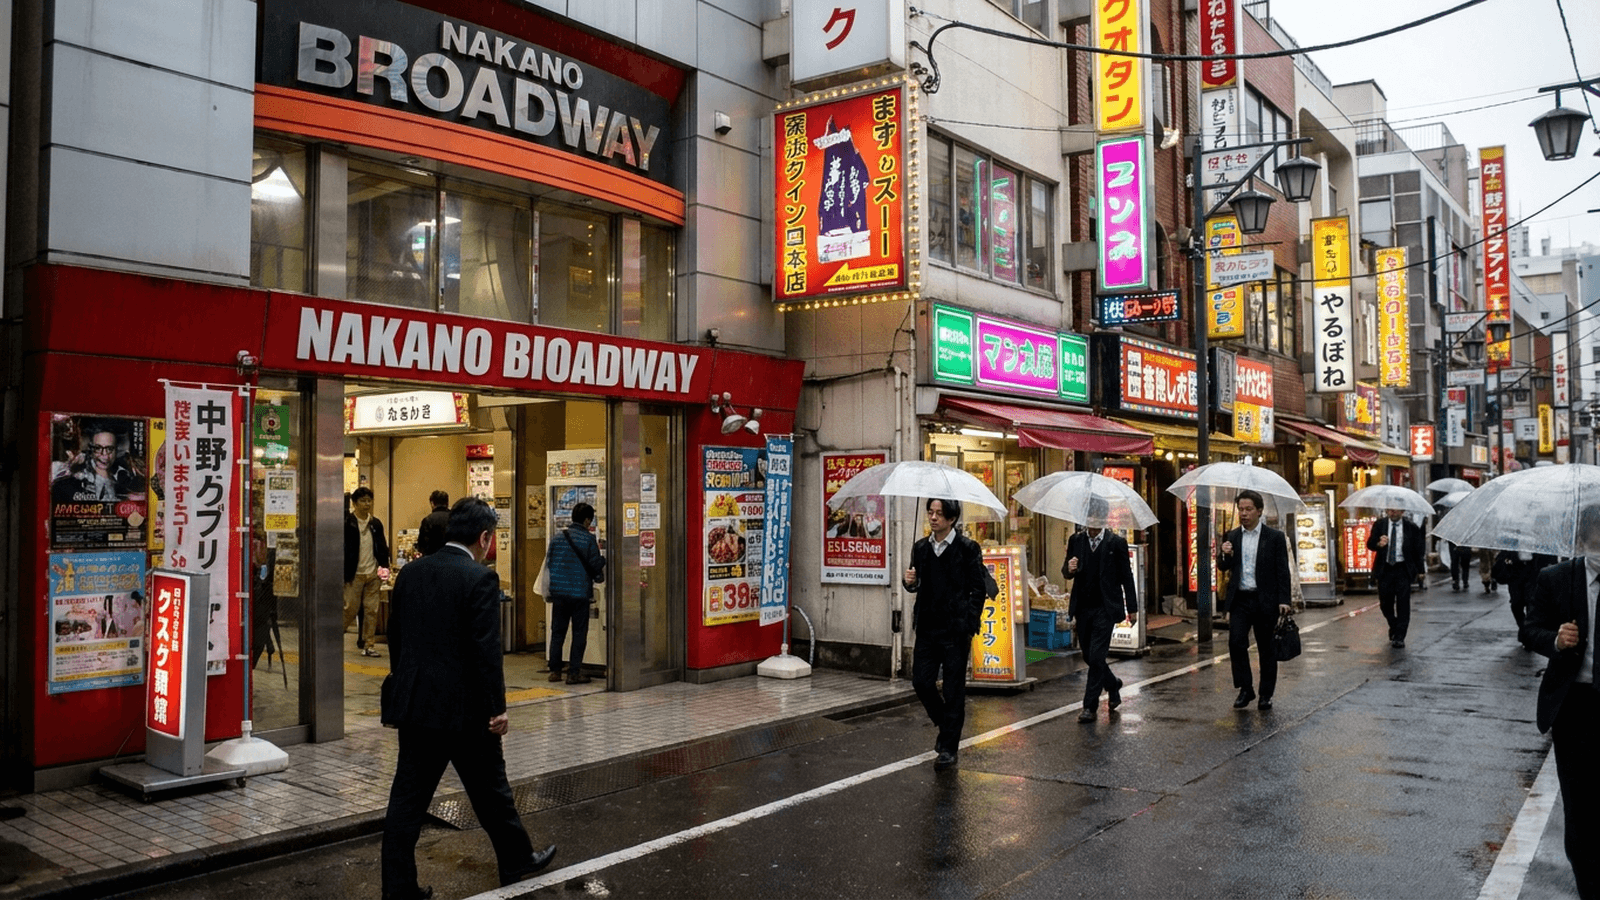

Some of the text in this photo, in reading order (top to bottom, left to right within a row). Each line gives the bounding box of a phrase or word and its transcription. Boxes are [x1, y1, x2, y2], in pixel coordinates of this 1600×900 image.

[441, 20, 583, 90] NAKANO
[822, 7, 857, 51] ク
[297, 21, 660, 171] BROADWAY
[297, 307, 699, 393] NAKANO BIOADWAY
